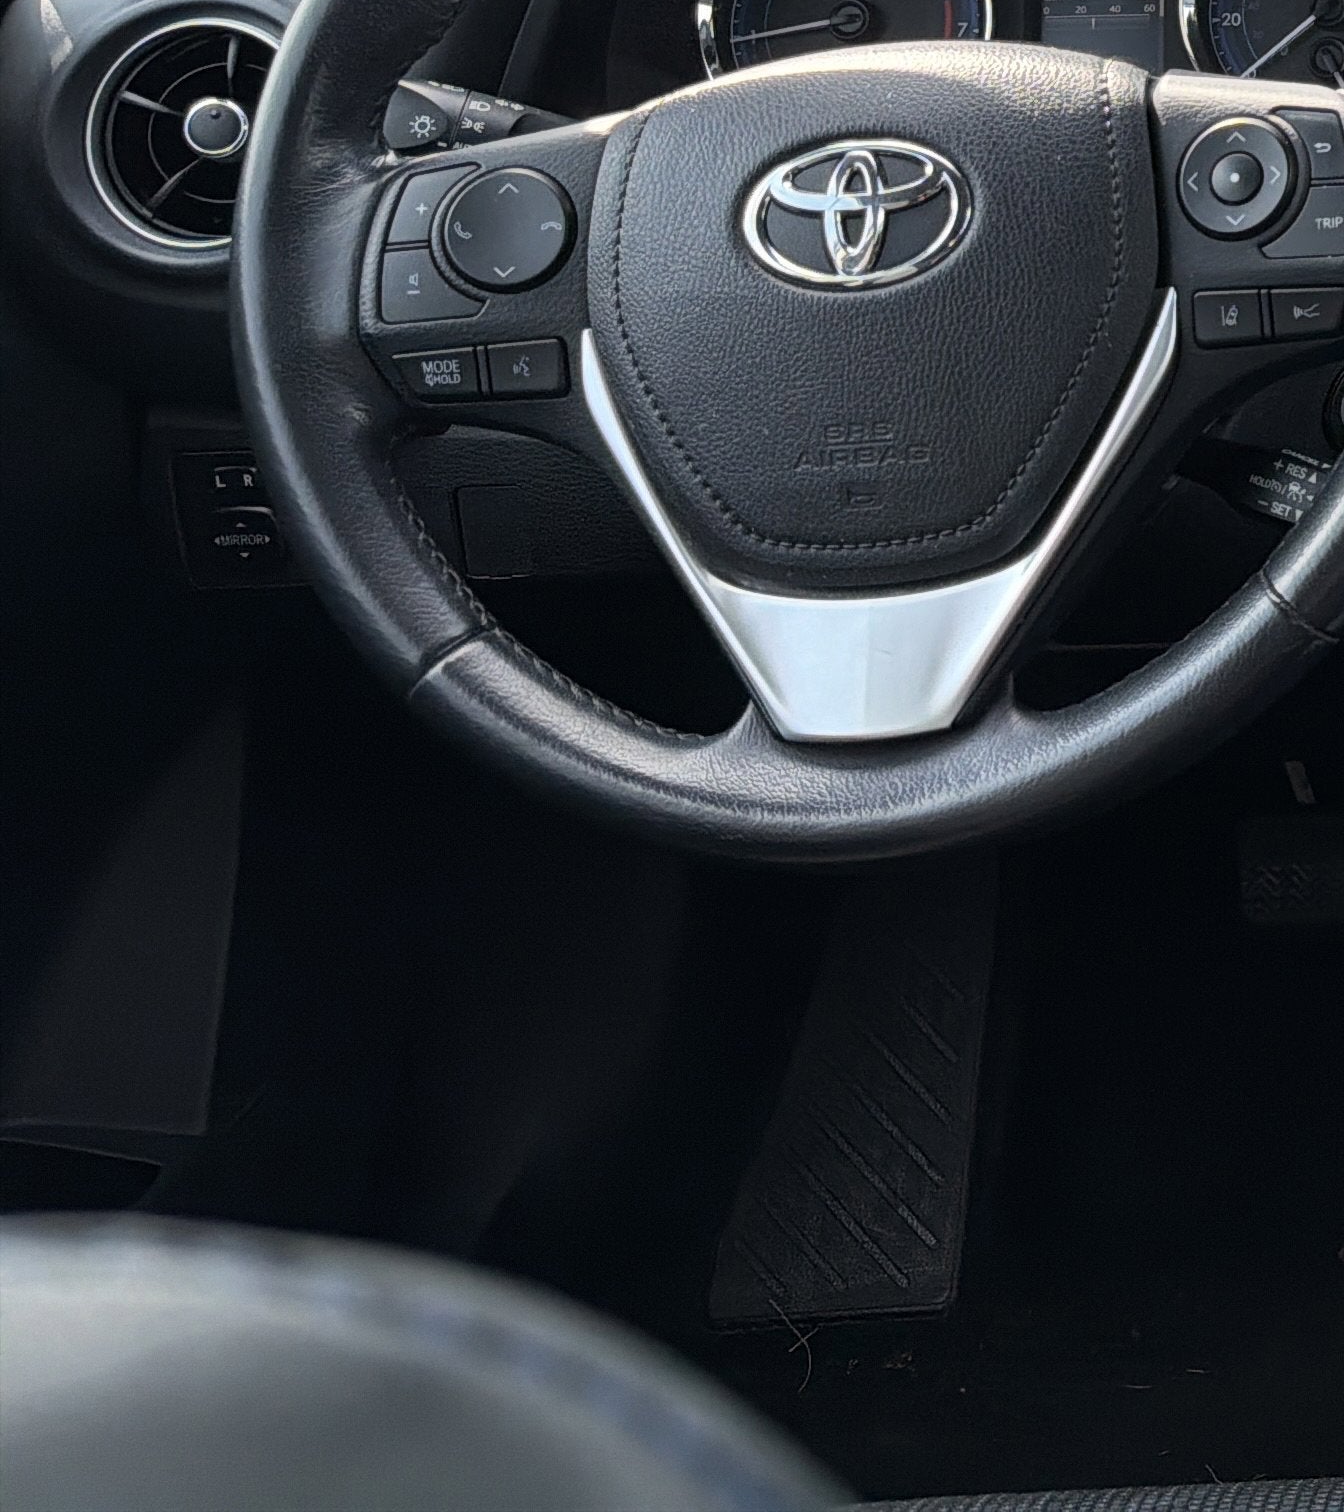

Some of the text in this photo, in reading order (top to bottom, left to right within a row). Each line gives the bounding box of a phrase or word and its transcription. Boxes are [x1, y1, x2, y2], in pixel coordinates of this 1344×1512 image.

[1043, 3, 1156, 14] 0 20 40 60
[1221, 12, 1241, 27] 20
[957, 21, 969, 38] 7
[1314, 216, 1344, 230] TRIP
[421, 359, 461, 374] MODE
[433, 373, 461, 385] HOLD
[793, 440, 936, 470] AIRBAG
[1285, 462, 1308, 479] RES
[215, 473, 254, 488] L R
[1248, 474, 1272, 489] HOLD
[1270, 501, 1293, 517] SET
[220, 534, 265, 546] MIRROR
